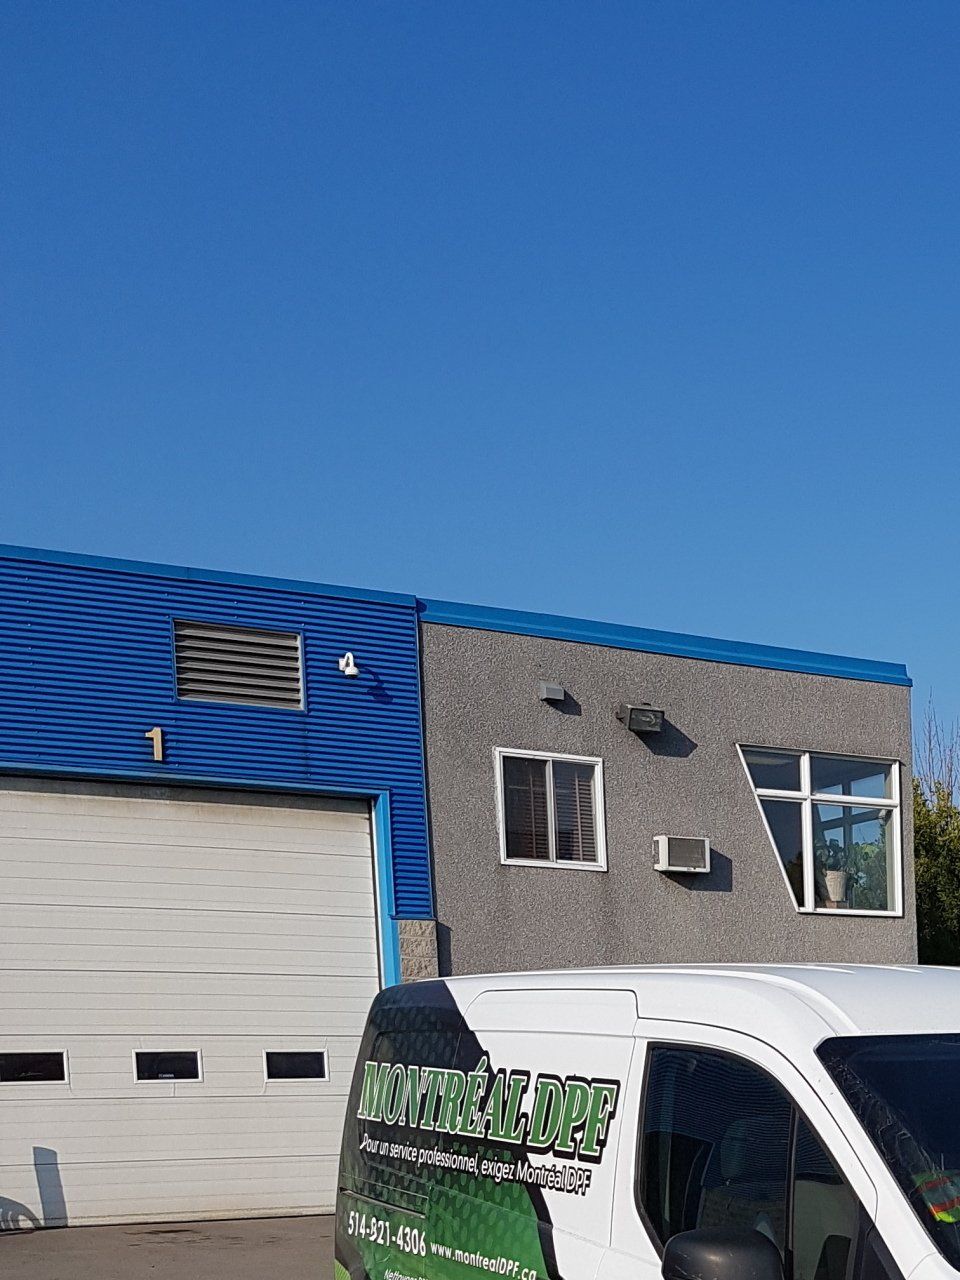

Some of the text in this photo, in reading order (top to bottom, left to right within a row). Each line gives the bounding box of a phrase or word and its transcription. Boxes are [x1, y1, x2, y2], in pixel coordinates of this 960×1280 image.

[145, 726, 162, 761] 1
[357, 1055, 618, 1156] MONTRÉAL DPF
[360, 1132, 591, 1193] Pour un service professionnel, exigez Montréal DPF
[348, 1210, 426, 1257] 514-821-4306
